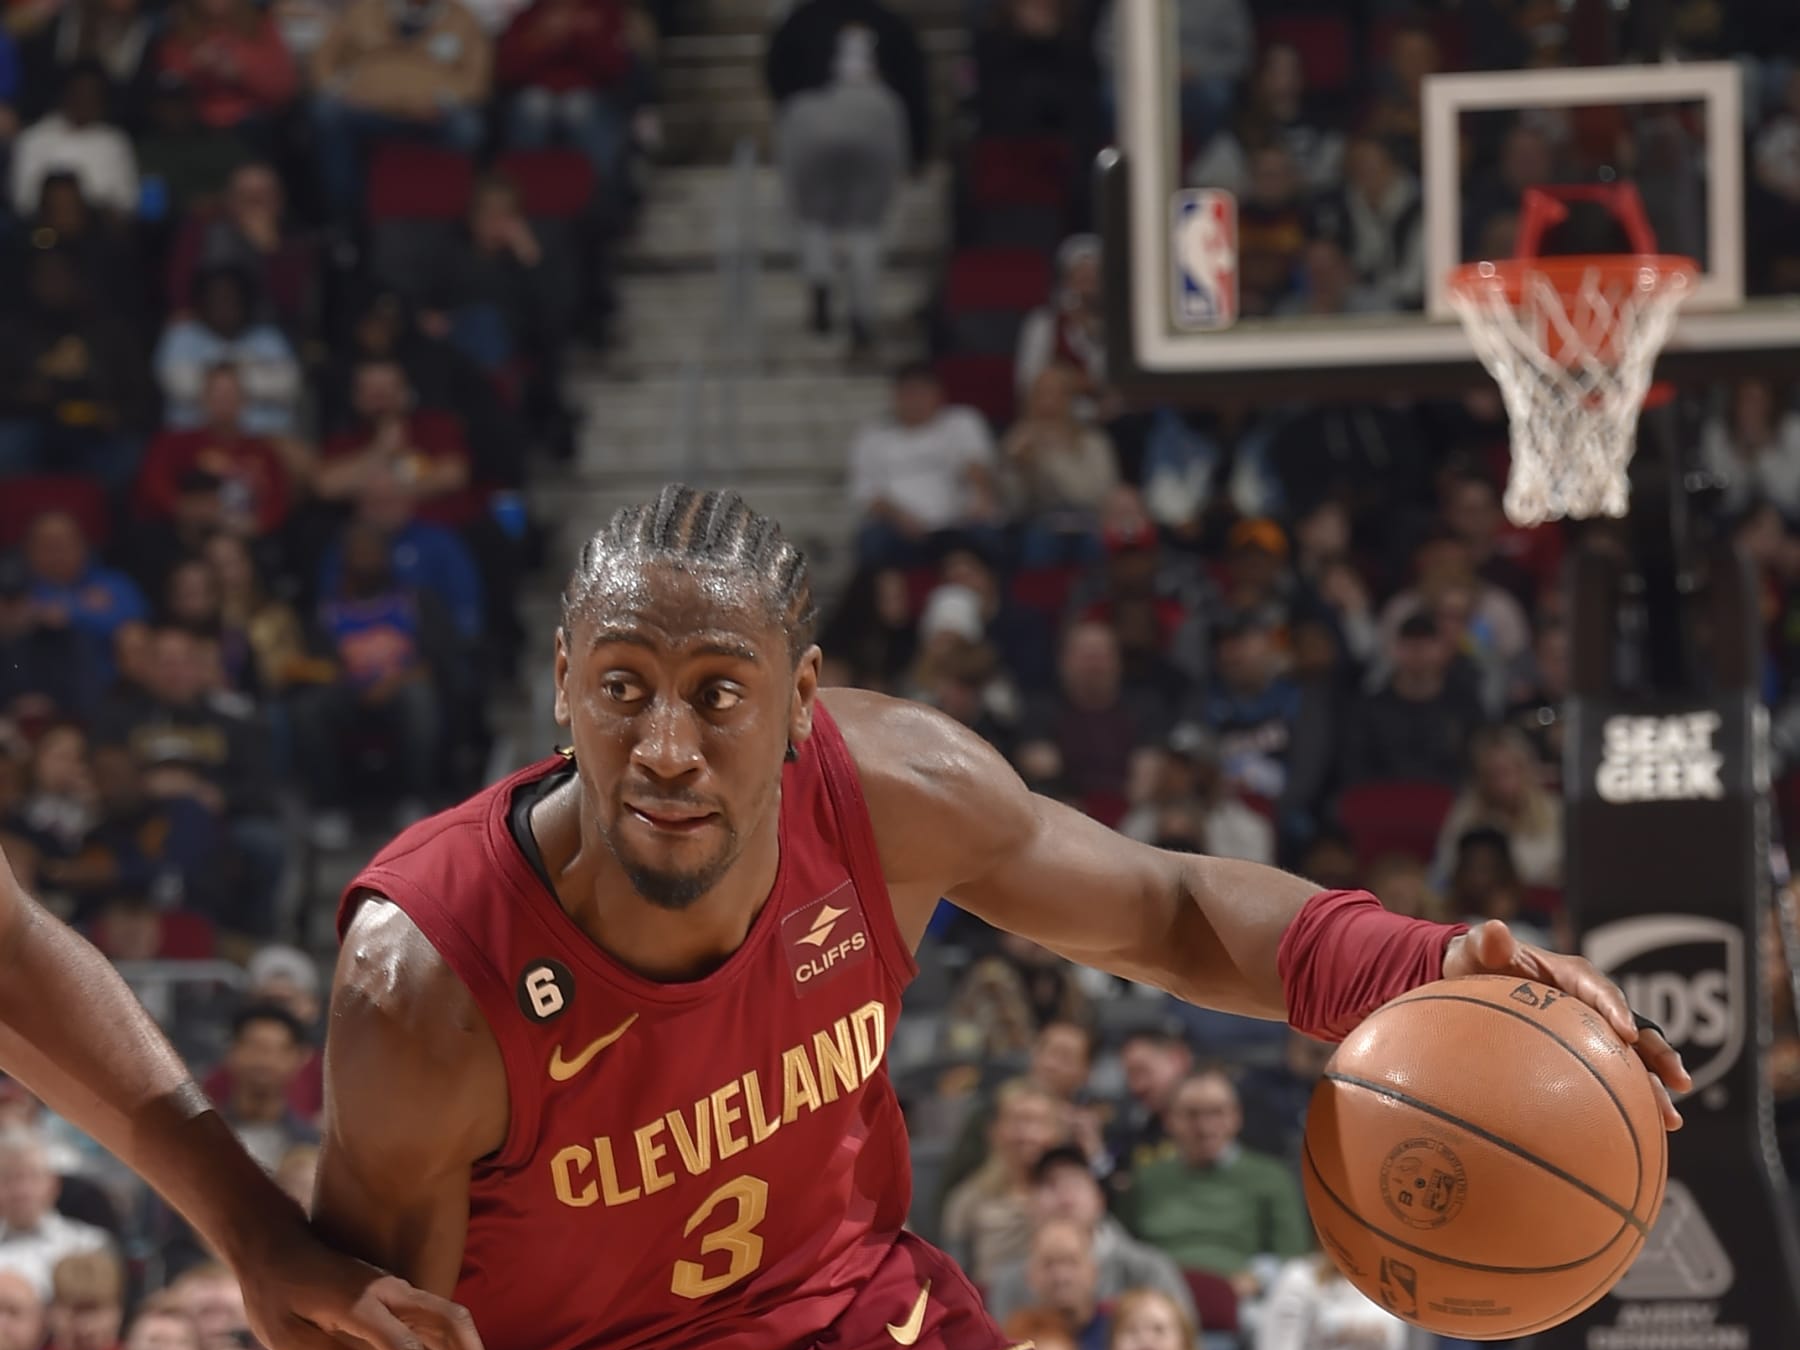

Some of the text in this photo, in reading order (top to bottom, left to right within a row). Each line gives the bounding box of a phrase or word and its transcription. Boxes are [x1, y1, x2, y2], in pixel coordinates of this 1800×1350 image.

[1602, 711, 1722, 760] SEAT
[1596, 755, 1725, 803] GEEK
[795, 931, 867, 983] CLIFFS
[525, 966, 564, 1018] 6
[550, 1000, 886, 1207] CLEVELAND
[671, 1174, 769, 1299] 3
